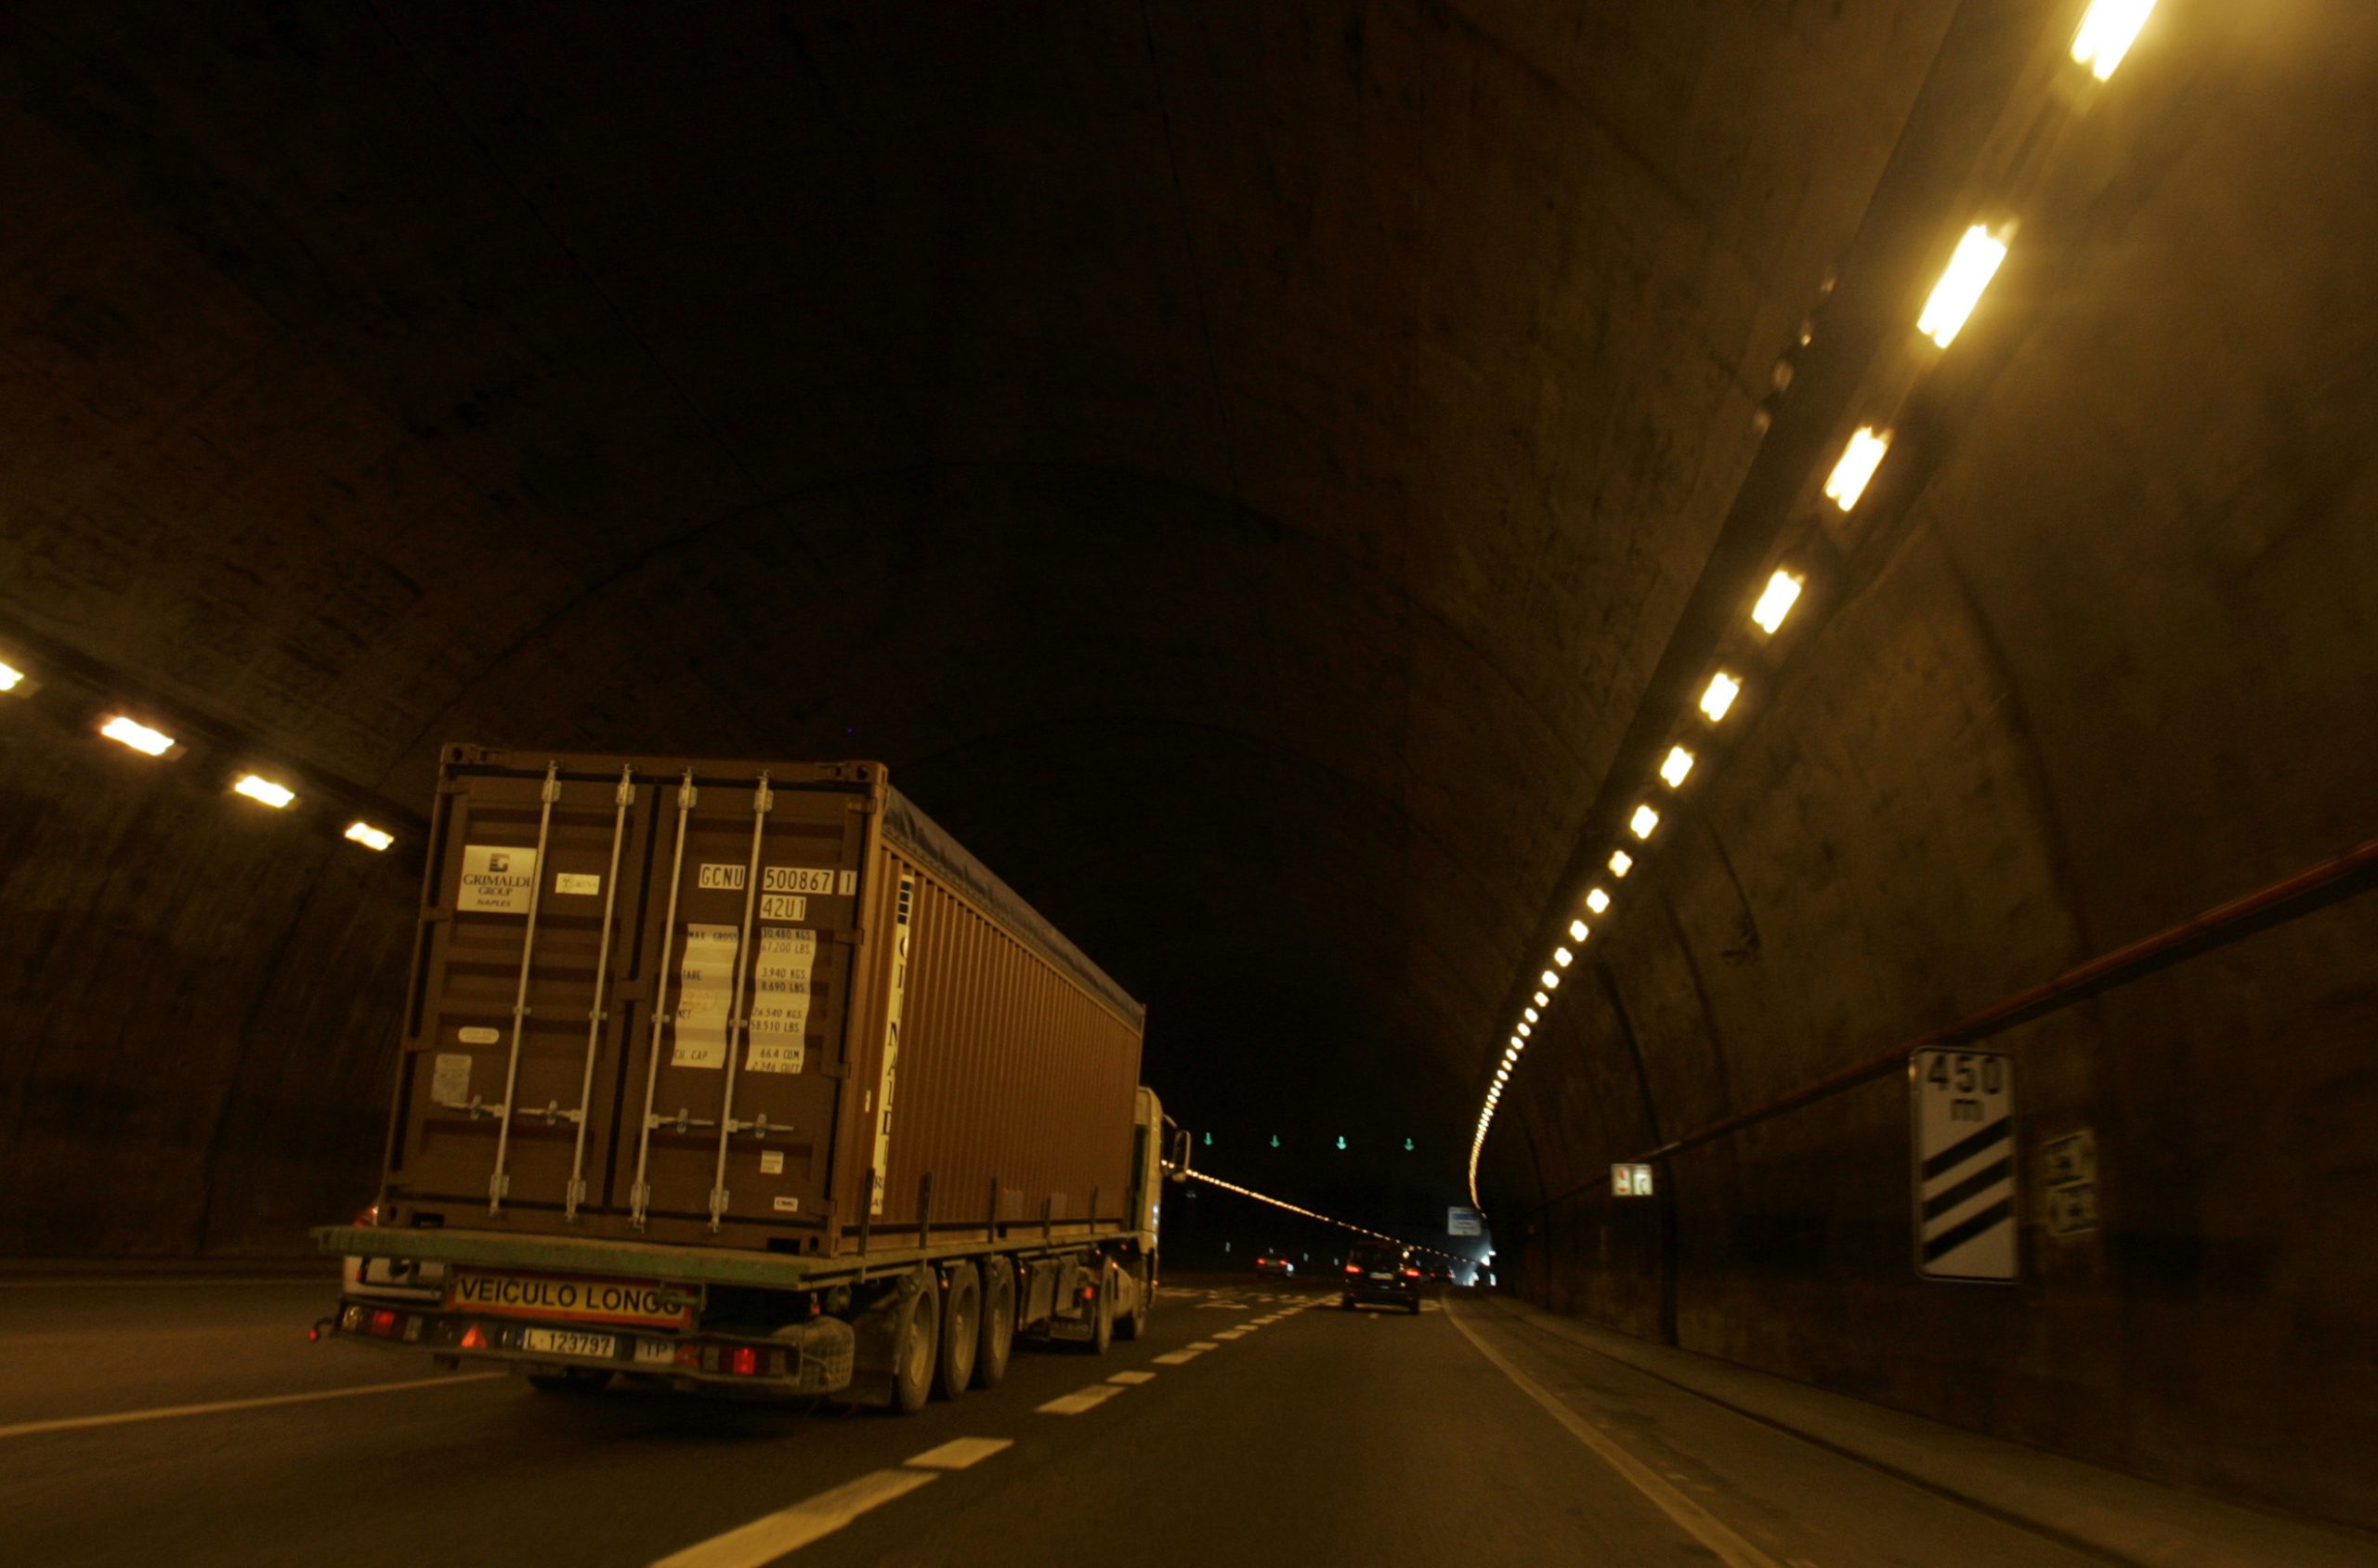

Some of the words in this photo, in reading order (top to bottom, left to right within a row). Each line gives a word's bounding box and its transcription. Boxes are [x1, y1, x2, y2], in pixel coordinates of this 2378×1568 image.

[464, 873, 530, 888] GRIMALDI
[701, 866, 744, 888] GCNU
[765, 869, 831, 892] 500867
[477, 887, 513, 896] GROUP
[763, 896, 804, 919] 42U1
[1927, 1054, 2002, 1094] 450
[461, 1278, 578, 1307] VEICULO
